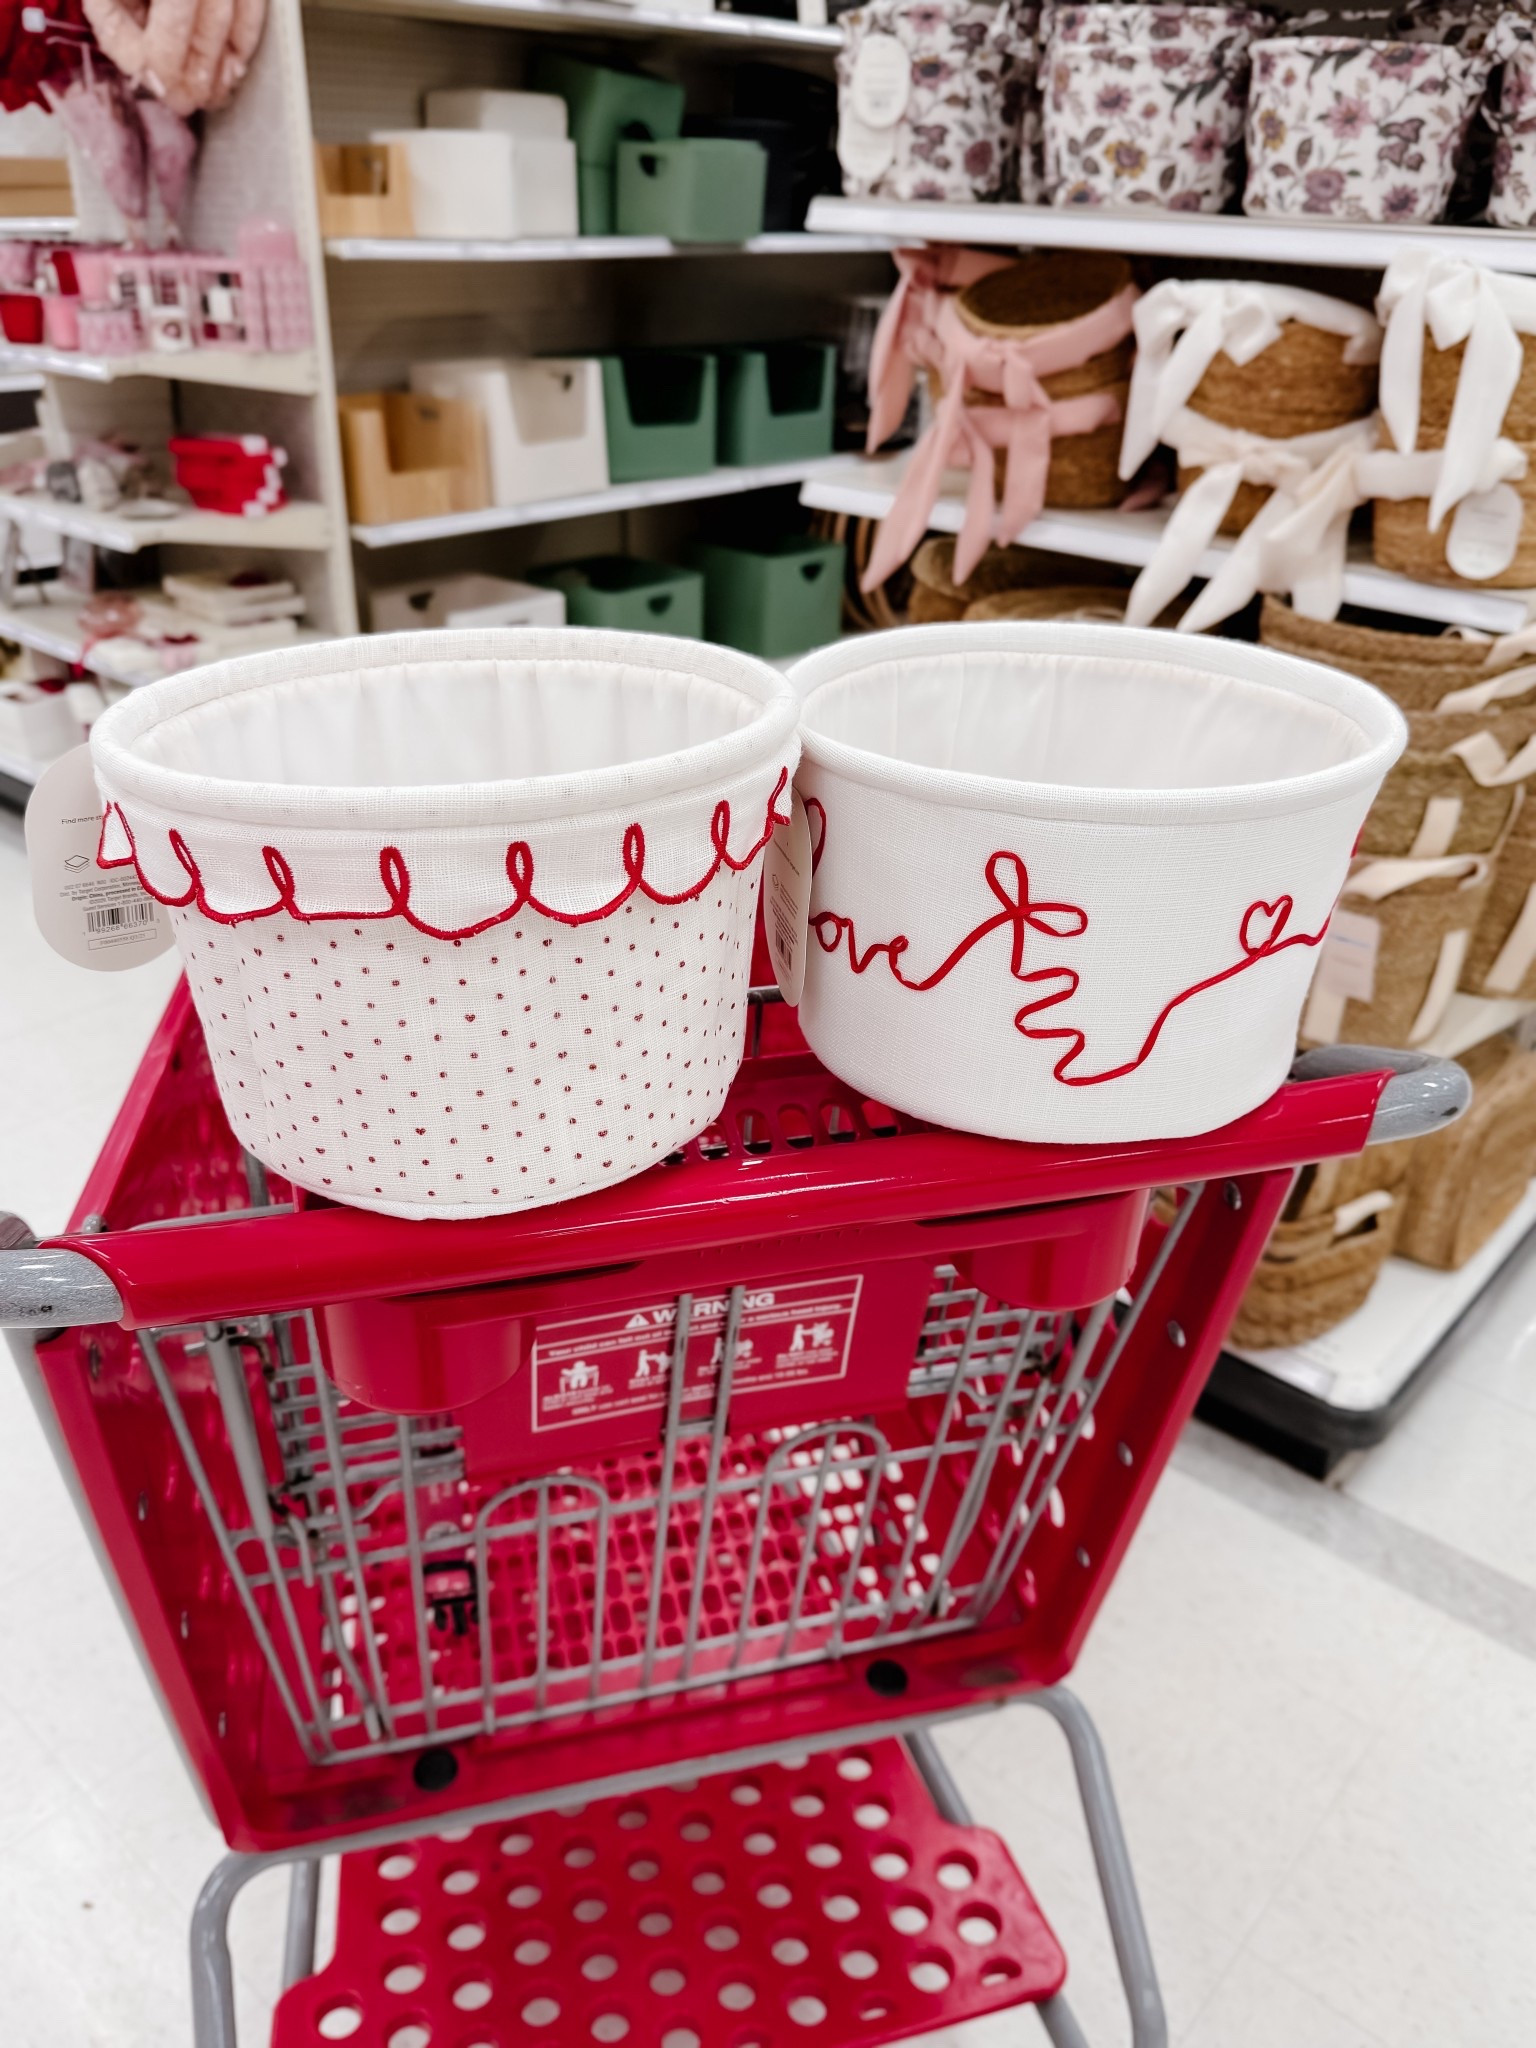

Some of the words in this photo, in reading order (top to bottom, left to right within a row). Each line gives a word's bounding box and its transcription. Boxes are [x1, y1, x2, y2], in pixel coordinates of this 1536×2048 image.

[96, 924, 121, 934] 99268
[123, 920, 149, 930] 66370
[652, 1292, 775, 1324] WRNNG
